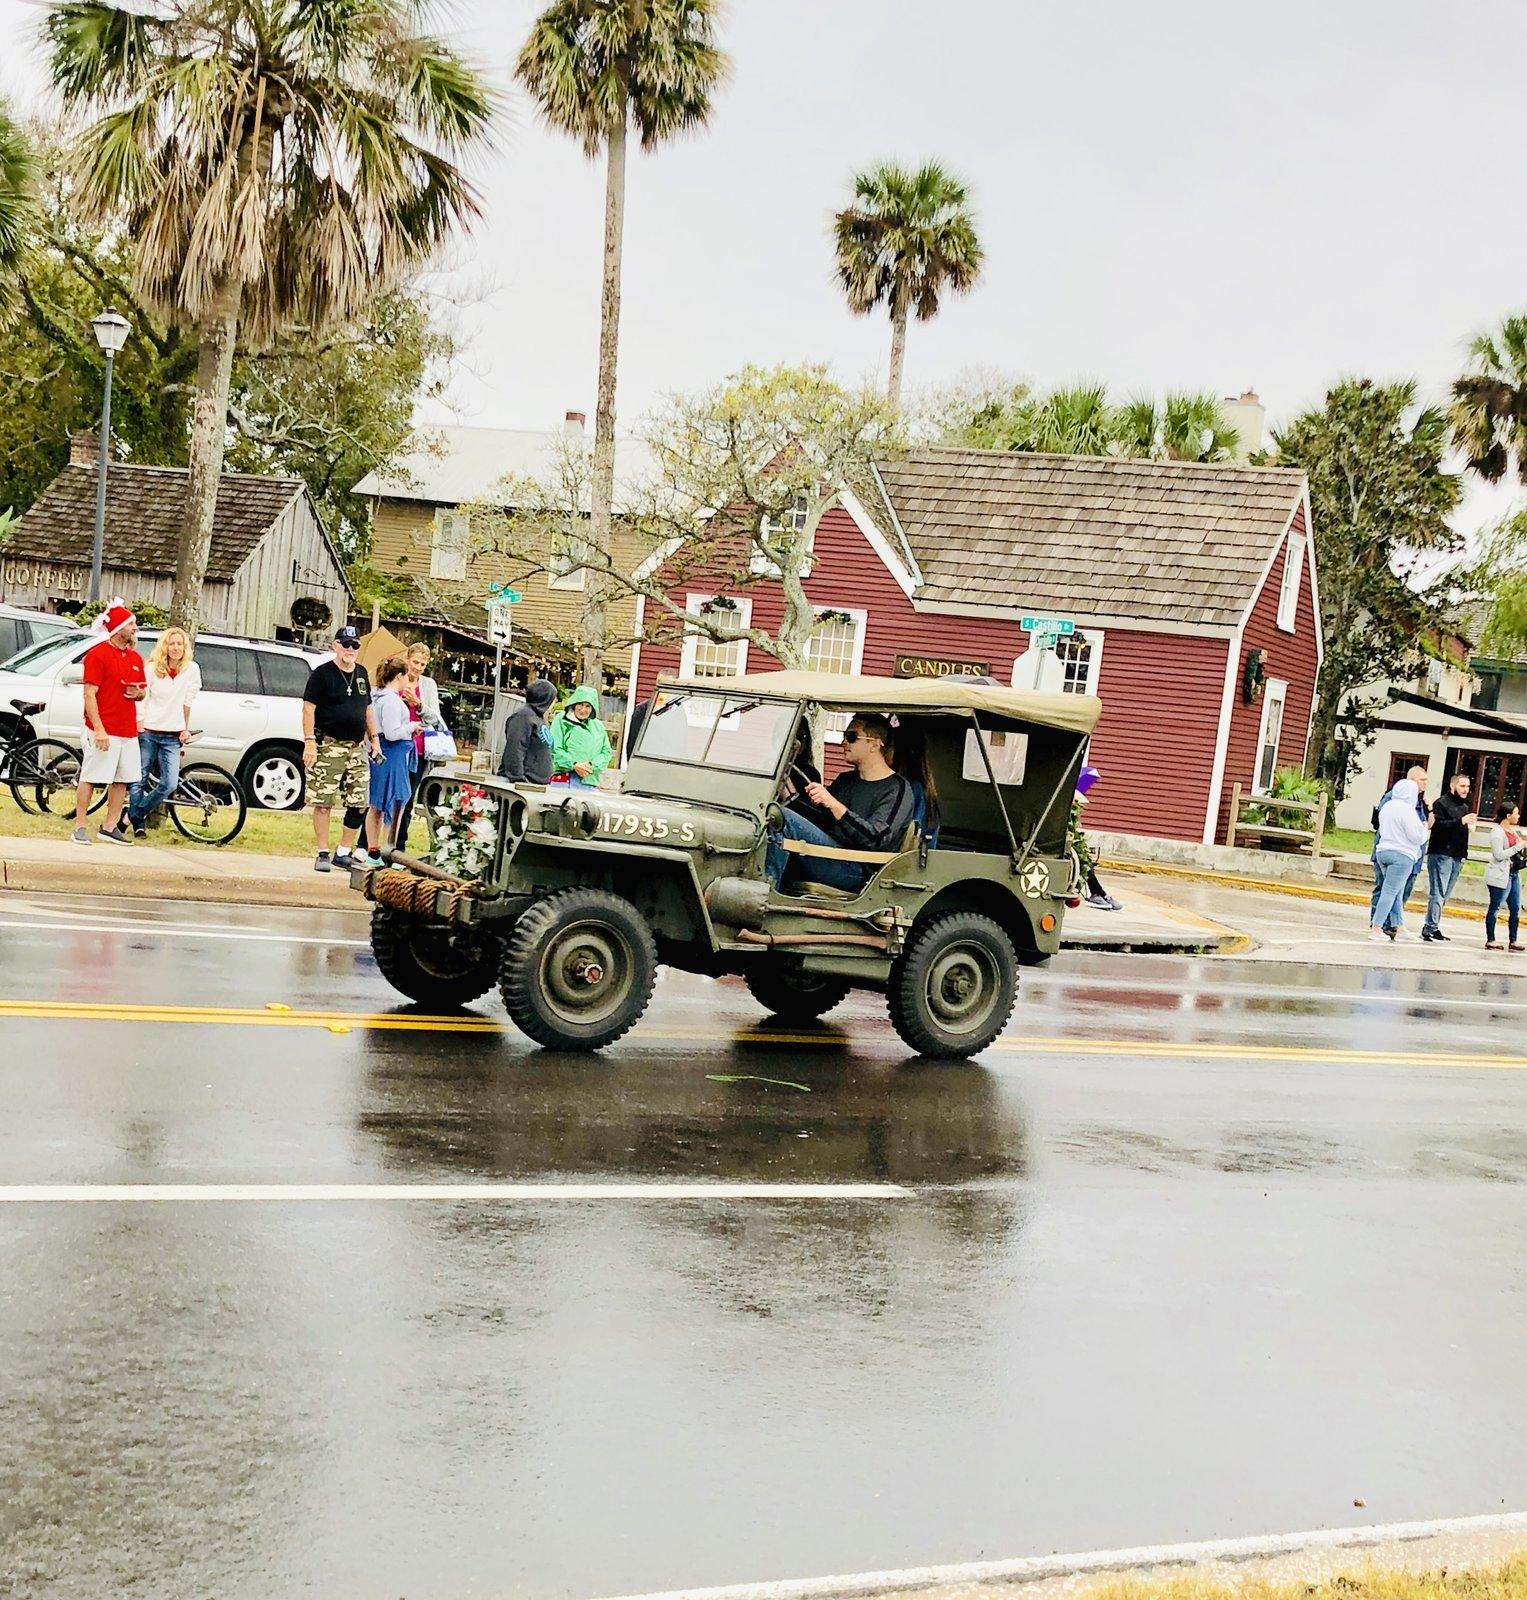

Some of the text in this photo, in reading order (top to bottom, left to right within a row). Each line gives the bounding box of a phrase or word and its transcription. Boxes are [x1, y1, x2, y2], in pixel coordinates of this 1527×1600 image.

[5, 567, 84, 591] COFFEE
[494, 607, 510, 618] ONE
[493, 619, 510, 627] WAY
[1032, 618, 1063, 632] Castillo
[900, 657, 983, 678] CANDLES
[597, 811, 695, 842] 17935-S
